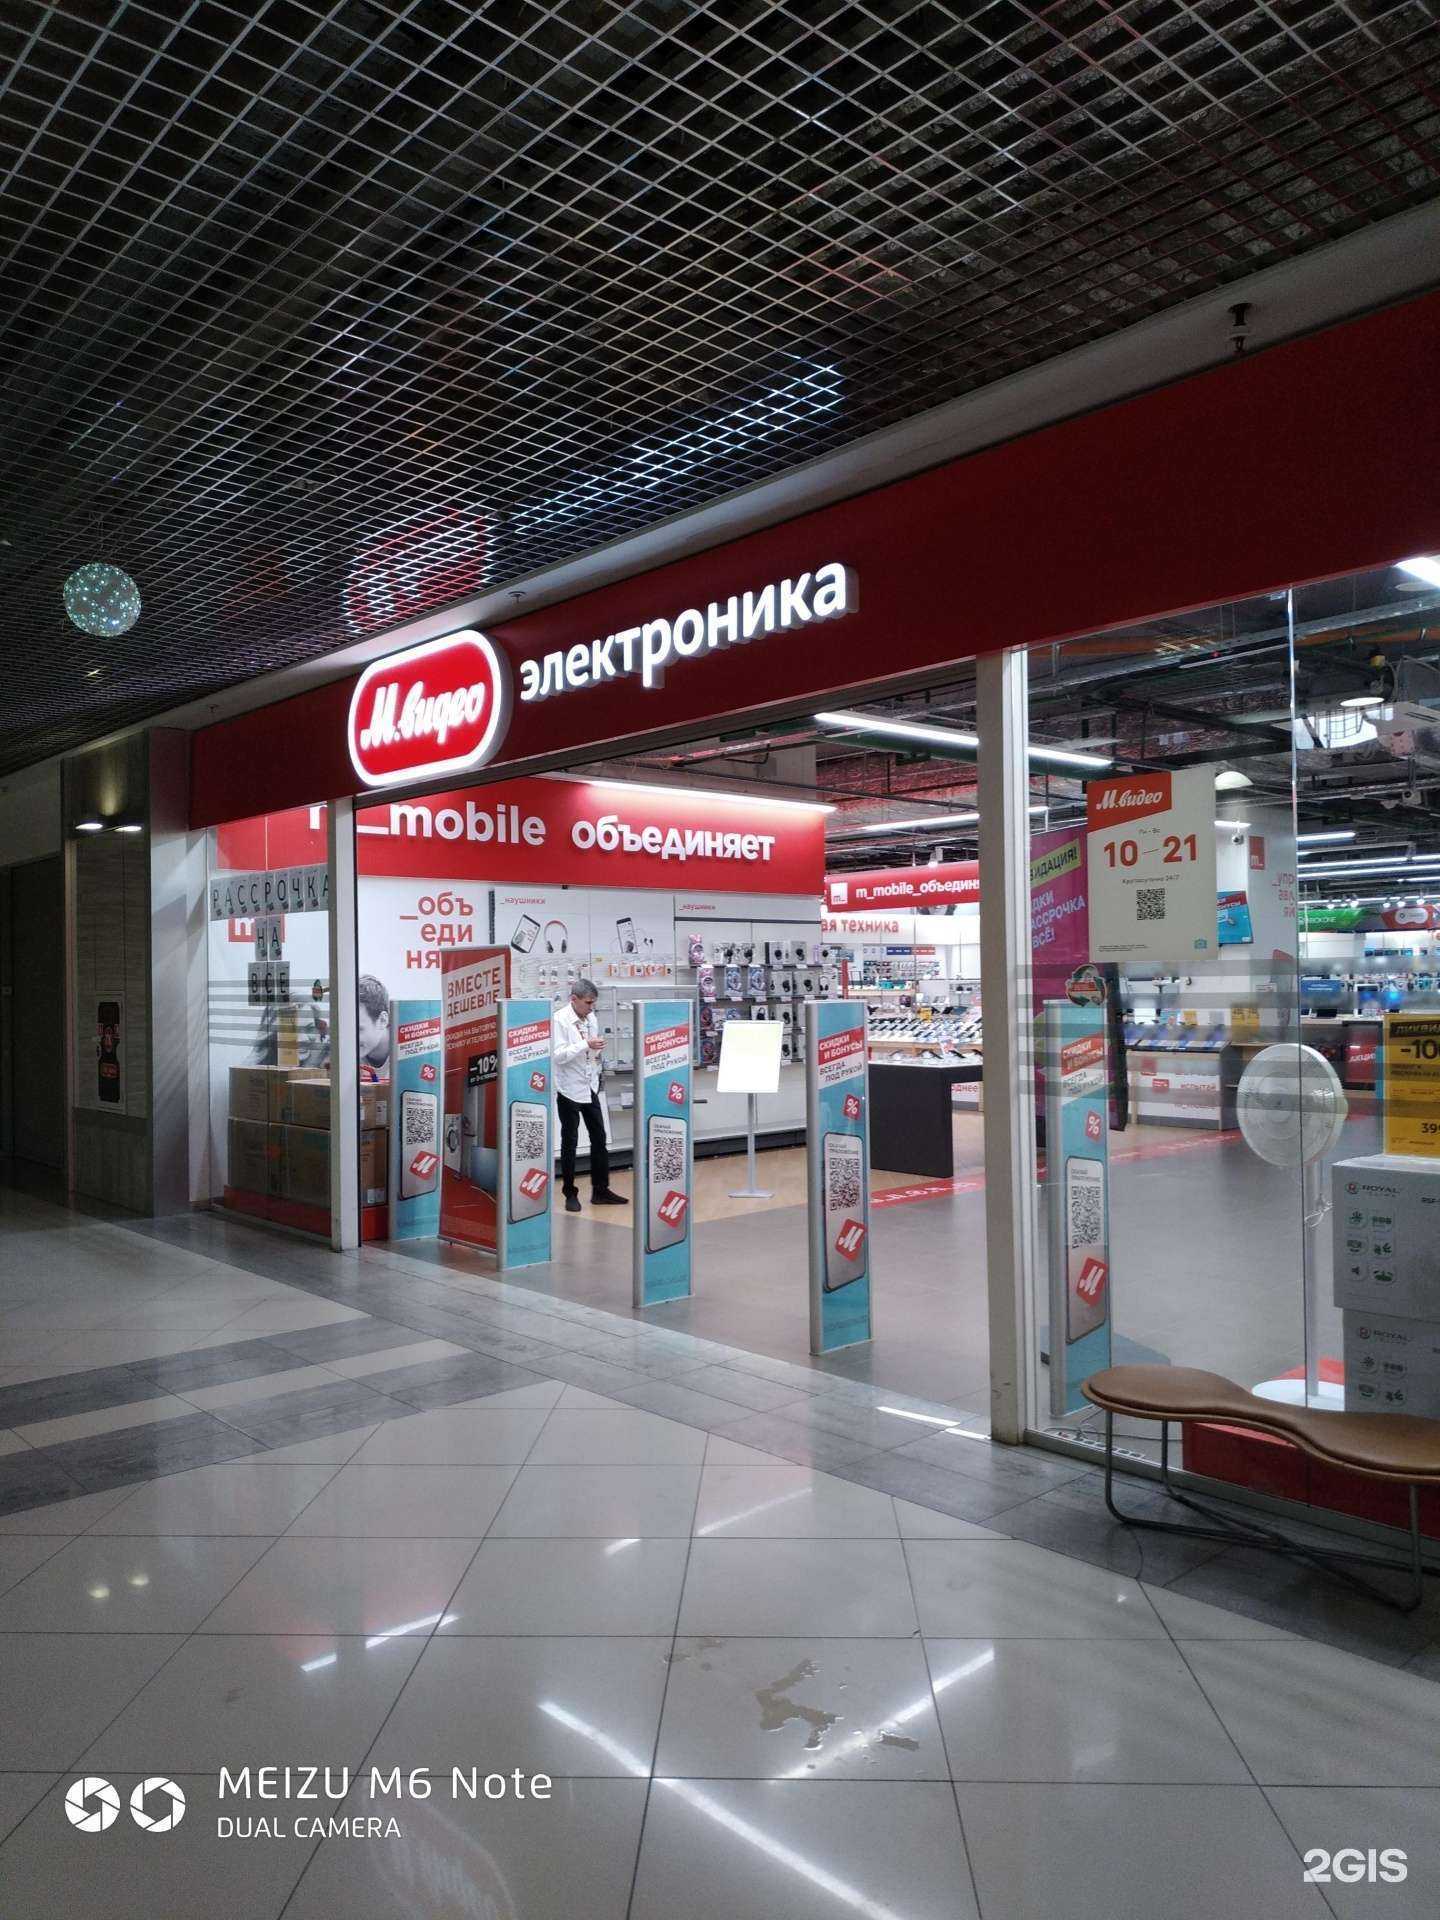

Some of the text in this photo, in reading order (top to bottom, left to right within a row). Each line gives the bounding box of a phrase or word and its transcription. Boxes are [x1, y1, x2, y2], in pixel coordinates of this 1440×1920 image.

[520, 562, 850, 701] электроника
[360, 680, 486, 750] М.видео
[1096, 789, 1163, 810] М.видео
[571, 814, 776, 861] объединяет
[213, 874, 329, 909] РАССРОЧКА
[420, 923, 473, 947] еди
[842, 918, 900, 934] техника
[257, 926, 280, 948] НА
[406, 950, 441, 969] ня
[251, 972, 287, 994] ВСЕ
[447, 966, 501, 998] ВМЕСТЕ
[446, 988, 501, 1020] ДЕШЕВЛЕ
[400, 1021, 429, 1034] СКИДКИ
[411, 1026, 440, 1039] БОНУСЫ
[508, 1025, 538, 1038] СКИДКИ
[520, 1030, 549, 1043] БОНУСЫ
[399, 1041, 423, 1051] ВСЕГДА
[646, 1030, 676, 1045] СКИДКИ
[657, 1035, 689, 1050] БОНУСЫ
[819, 1034, 850, 1052] СКИДКИ
[508, 1045, 533, 1057] ВСЕГДА
[512, 1047, 549, 1062] ПОД РУКОЙ
[831, 1040, 863, 1058] БОНУСЫ
[1400, 1038, 1440, 1060] -10
[645, 1053, 671, 1066] ВСЕГДА
[650, 1054, 688, 1072] ПОД РУКОЙ
[819, 1061, 847, 1076] ВСЕГДА
[825, 1062, 863, 1083] ПОД РУКОЙ
[1362, 1184, 1401, 1194] ROYAL
